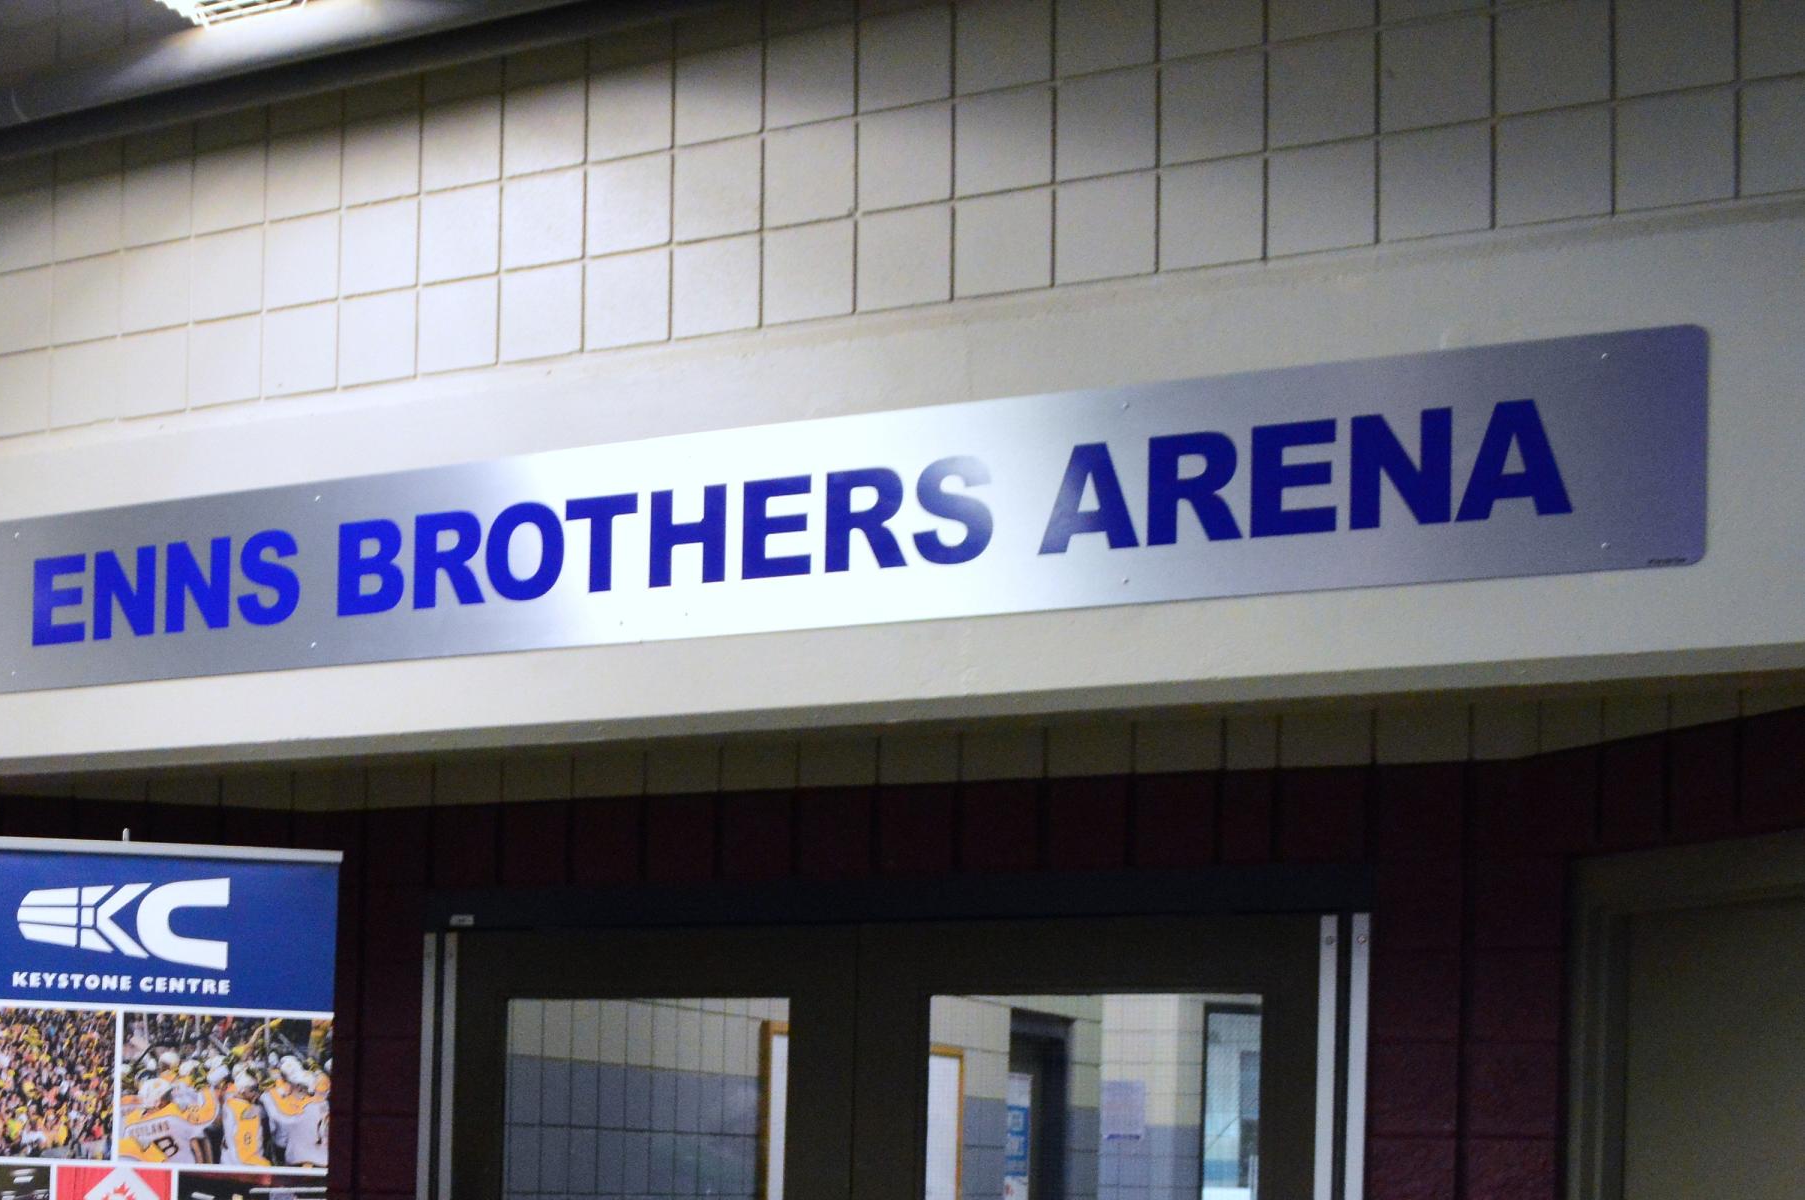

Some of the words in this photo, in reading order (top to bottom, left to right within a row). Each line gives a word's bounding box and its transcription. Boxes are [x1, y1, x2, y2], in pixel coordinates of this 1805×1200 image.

[31, 528, 300, 647] ENNS
[336, 454, 995, 618] BROTHERS
[1037, 399, 1574, 555] ARENA
[11, 970, 132, 992] KEYSTONE
[139, 976, 231, 996] CENTRE
